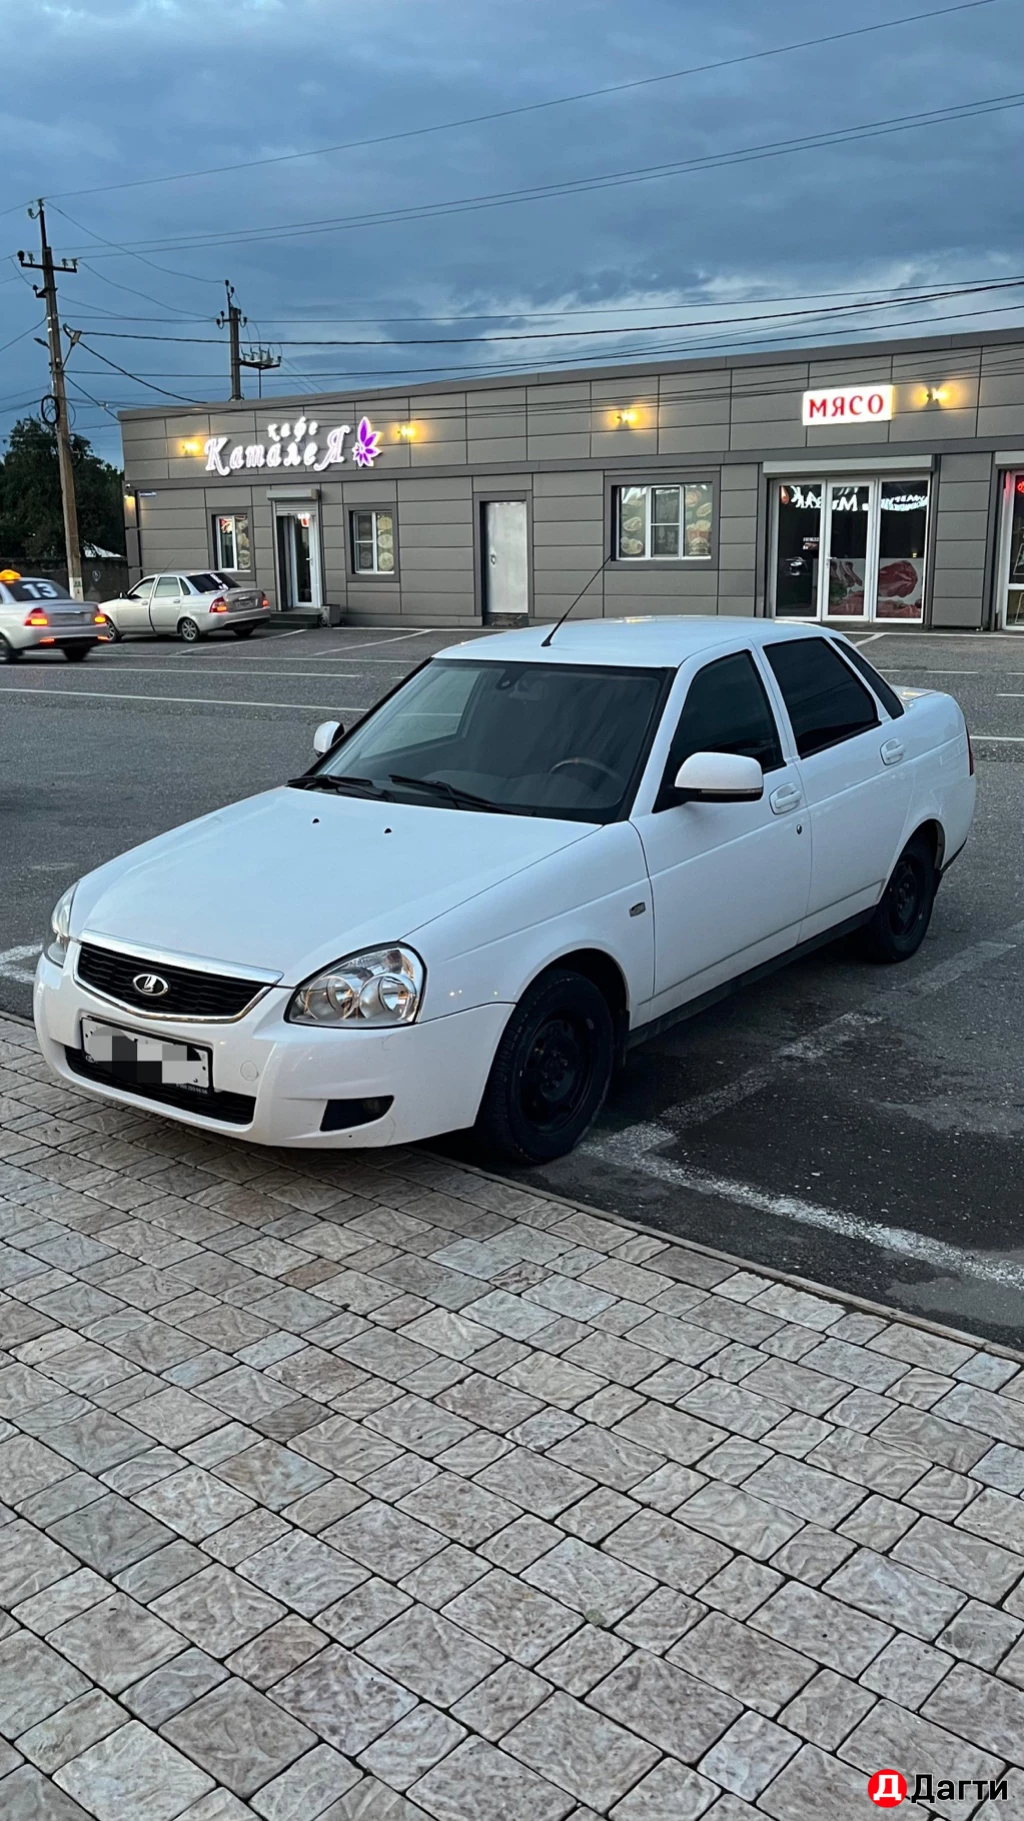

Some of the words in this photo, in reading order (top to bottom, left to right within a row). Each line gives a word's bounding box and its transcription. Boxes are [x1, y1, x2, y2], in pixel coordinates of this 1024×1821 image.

[809, 393, 884, 418] МЯСО
[267, 416, 318, 441] кафе
[22, 583, 58, 598] 13
